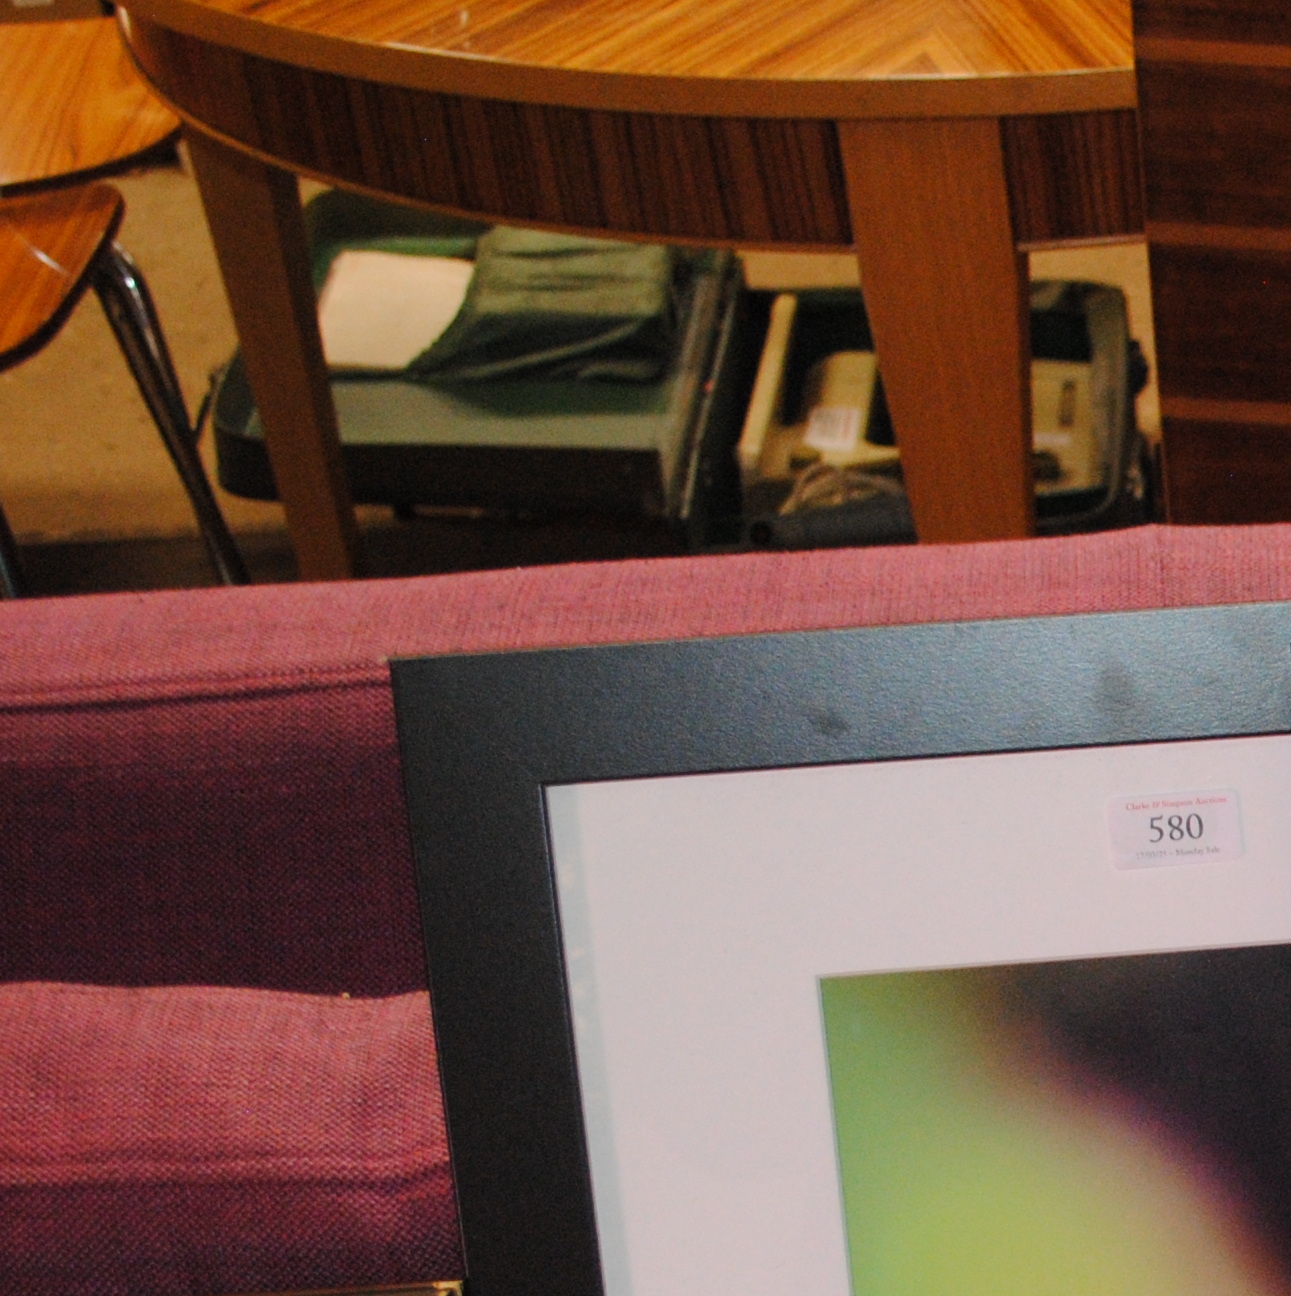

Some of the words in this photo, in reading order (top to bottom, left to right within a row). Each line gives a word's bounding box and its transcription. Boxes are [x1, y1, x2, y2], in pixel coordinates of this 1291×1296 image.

[1125, 802, 1150, 811] Clarke
[1195, 797, 1227, 805] Auctions
[1149, 812, 1204, 843] 580
[1175, 847, 1204, 856] Monday
